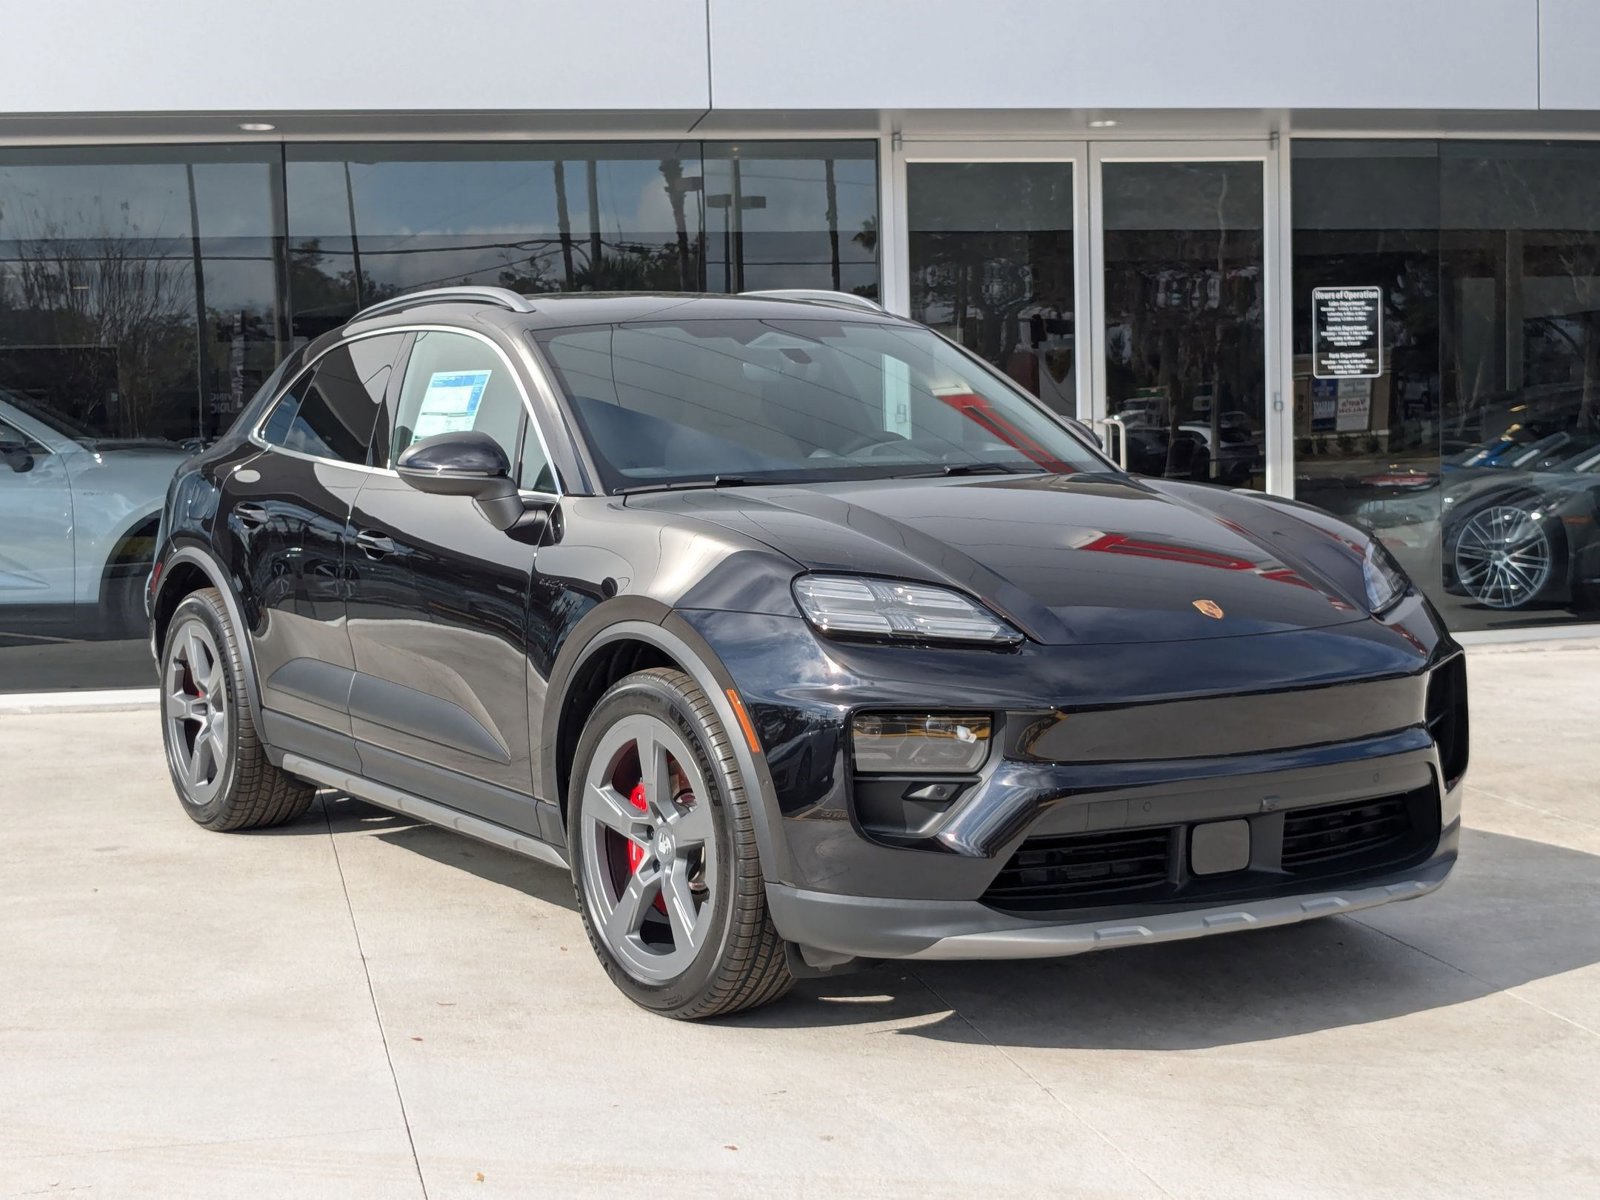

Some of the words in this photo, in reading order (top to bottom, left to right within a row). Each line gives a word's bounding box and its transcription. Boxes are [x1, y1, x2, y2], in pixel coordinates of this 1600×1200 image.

[1315, 291, 1335, 300] Hours
[1335, 291, 1343, 299] of
[1343, 290, 1377, 301] Operation
